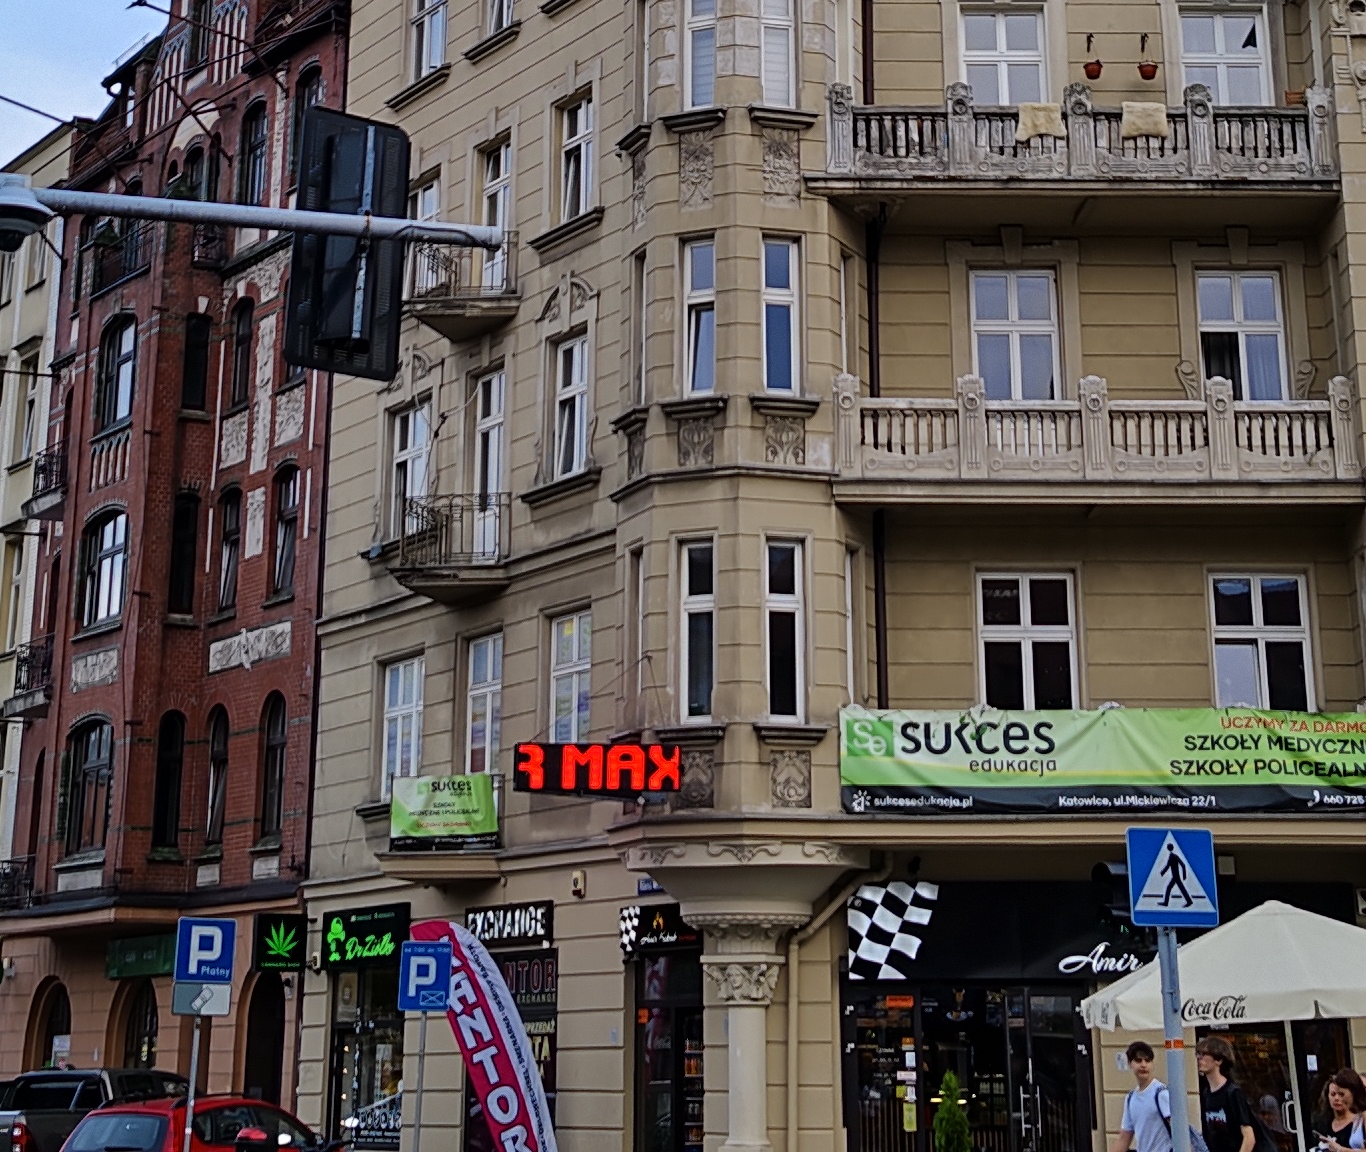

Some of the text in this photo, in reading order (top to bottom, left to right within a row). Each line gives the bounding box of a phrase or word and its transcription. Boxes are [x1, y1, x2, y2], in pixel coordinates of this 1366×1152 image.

[900, 721, 1056, 755] sukces
[1221, 716, 1284, 730] UCZYMY
[1289, 720, 1309, 732] ZA
[1184, 734, 1262, 752] SZKOŁY
[561, 745, 679, 790] MAX
[969, 758, 1057, 777] edukacja
[1170, 759, 1248, 776] SZKOŁY
[874, 795, 973, 808] sukcesedukacja.pl
[1059, 795, 1112, 807] Katowice,
[467, 905, 547, 941] EXCHANGE
[188, 925, 223, 975] P
[1058, 942, 1145, 975] Amir
[407, 955, 437, 997] P
[503, 960, 556, 994] NTOR
